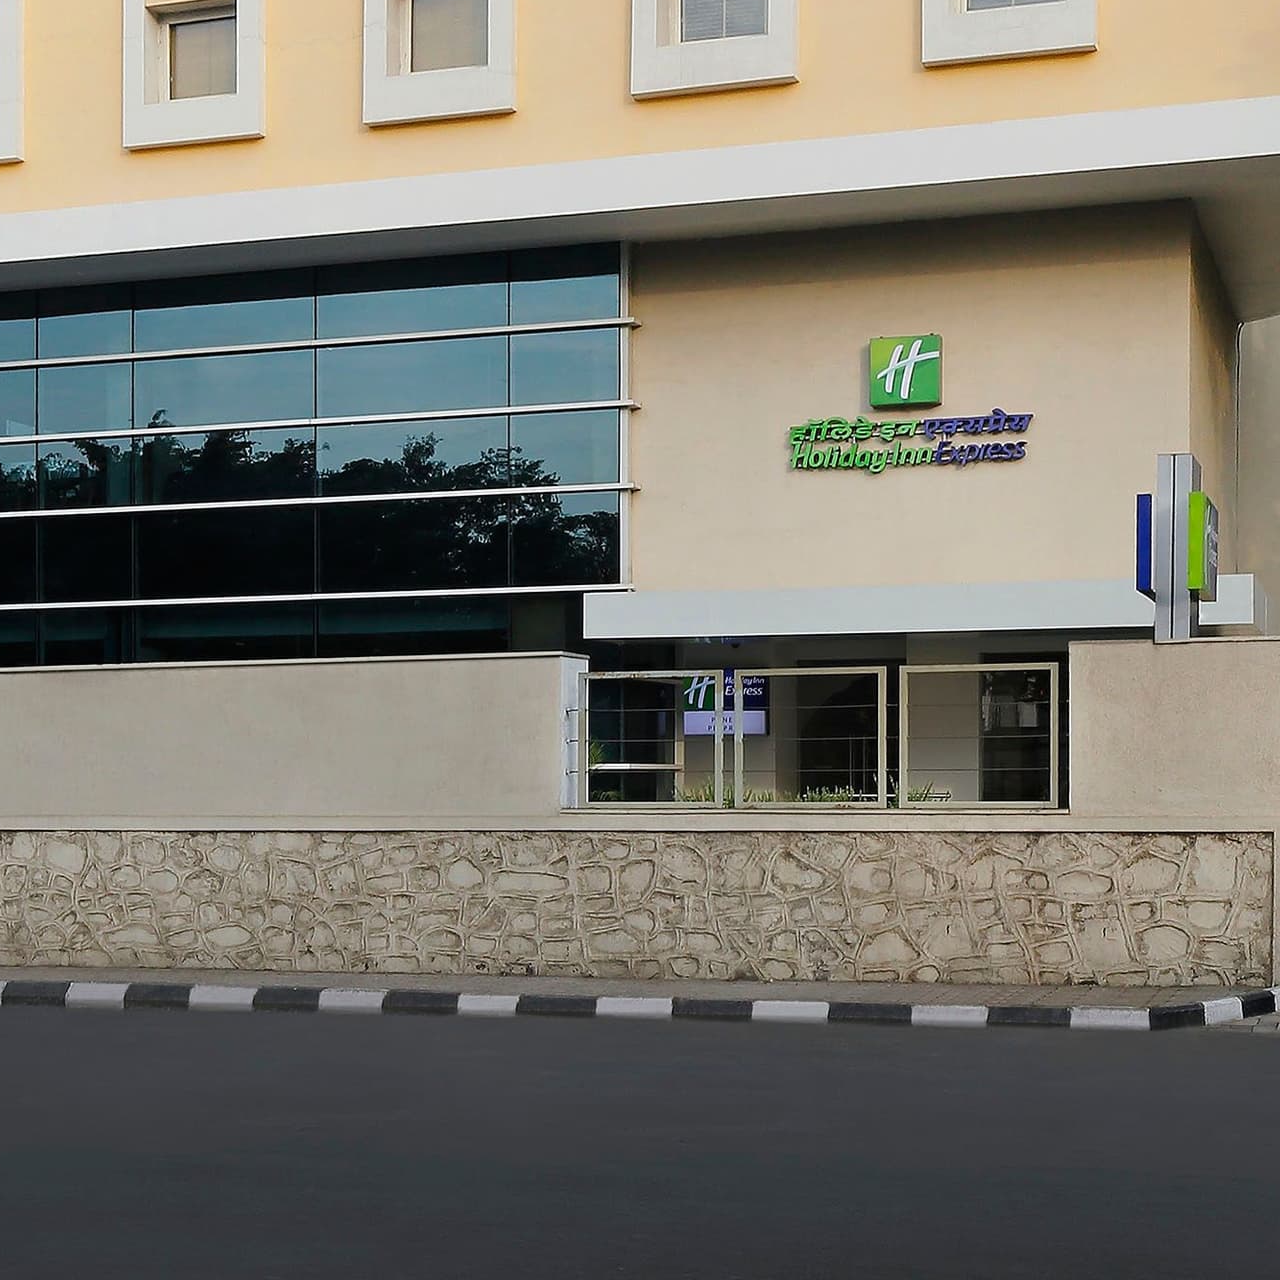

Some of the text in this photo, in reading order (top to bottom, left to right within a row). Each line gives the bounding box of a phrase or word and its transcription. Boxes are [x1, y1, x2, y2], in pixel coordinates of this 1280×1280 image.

[791, 440, 1028, 473] Holiday Inn Express
[711, 716, 732, 724] PNE
